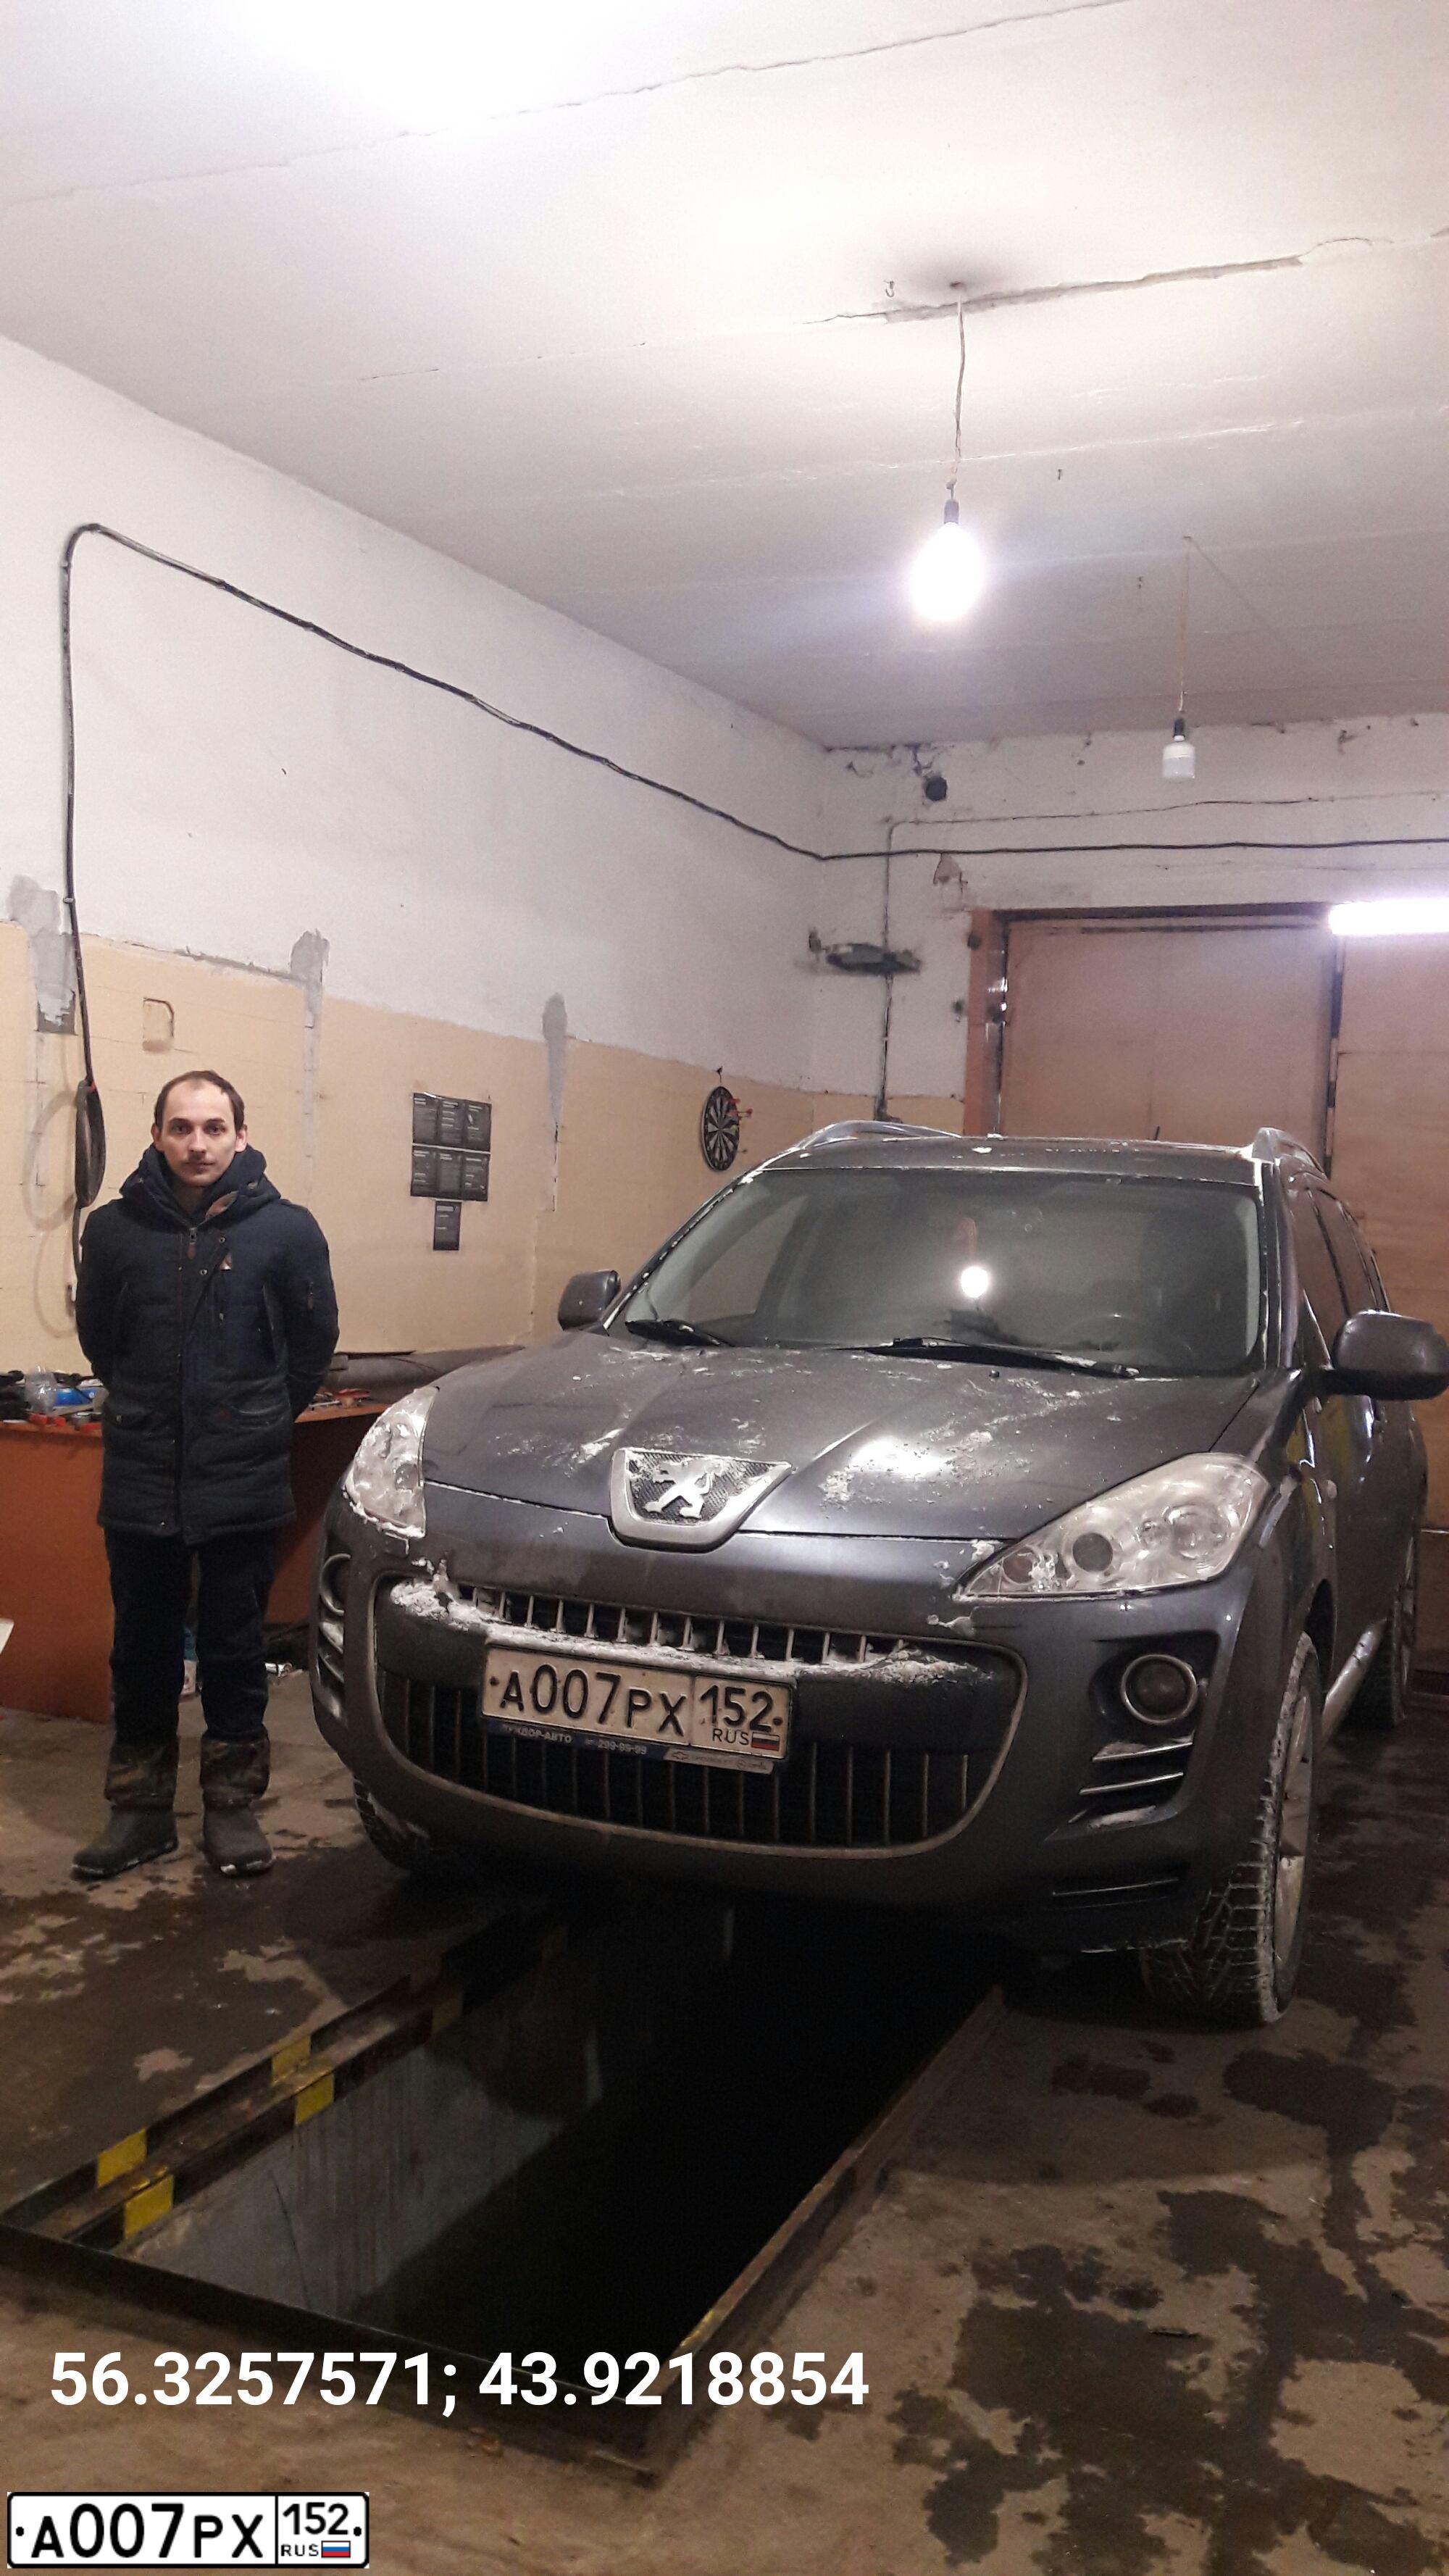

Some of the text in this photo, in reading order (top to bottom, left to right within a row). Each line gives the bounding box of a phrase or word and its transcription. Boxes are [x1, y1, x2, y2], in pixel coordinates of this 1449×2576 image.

[500, 1663, 774, 1737] А007РХ 152
[712, 1728, 749, 1746] RUS
